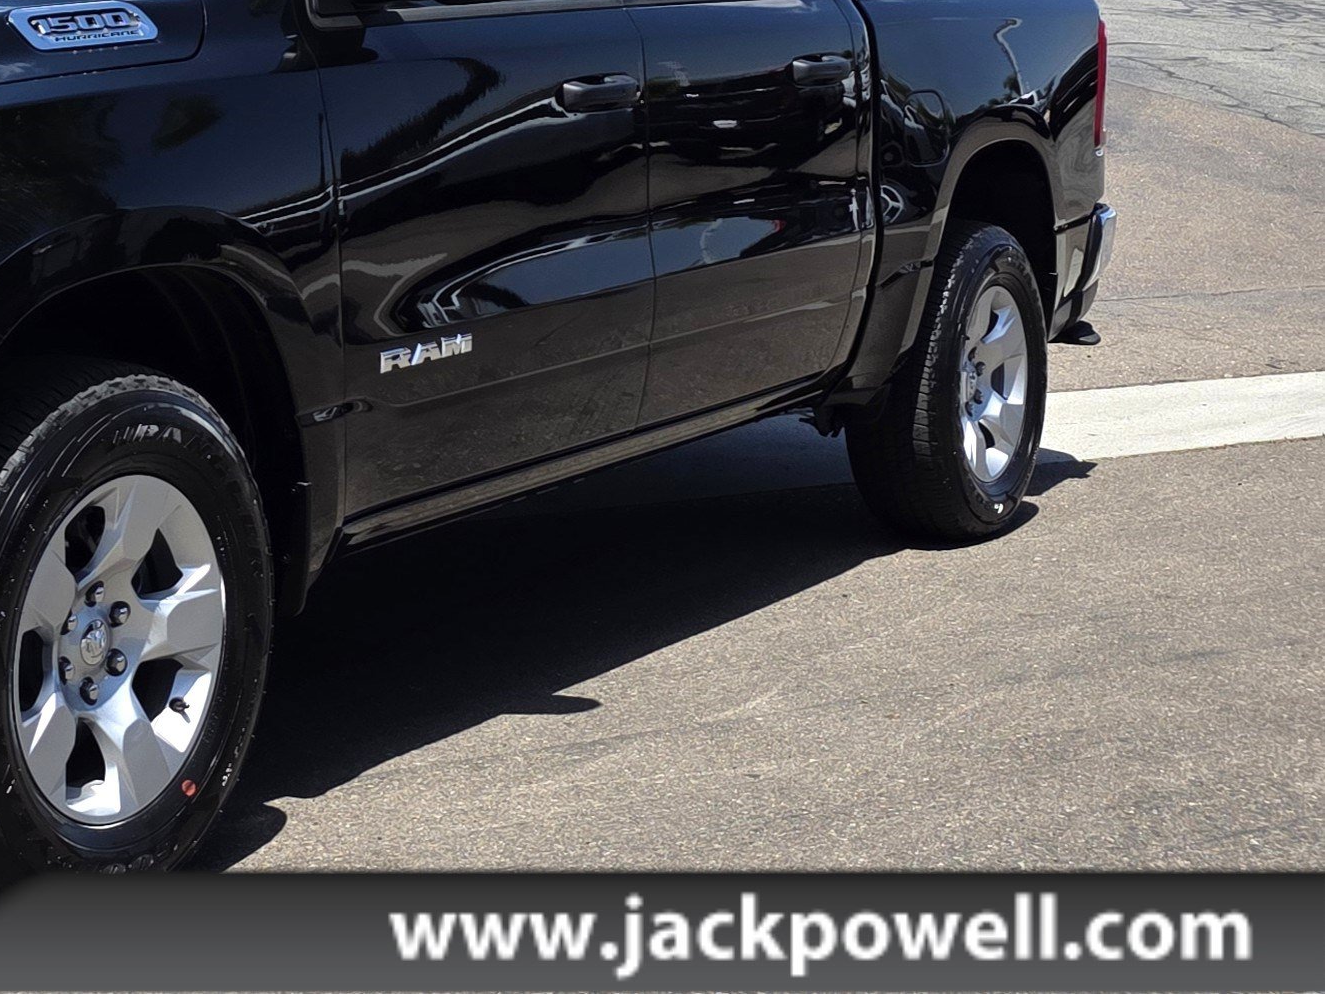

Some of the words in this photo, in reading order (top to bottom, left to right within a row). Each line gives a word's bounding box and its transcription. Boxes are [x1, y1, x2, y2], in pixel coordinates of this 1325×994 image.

[31, 11, 133, 36] 1500
[55, 29, 140, 42] HURRICANE
[379, 333, 473, 374] RAM
